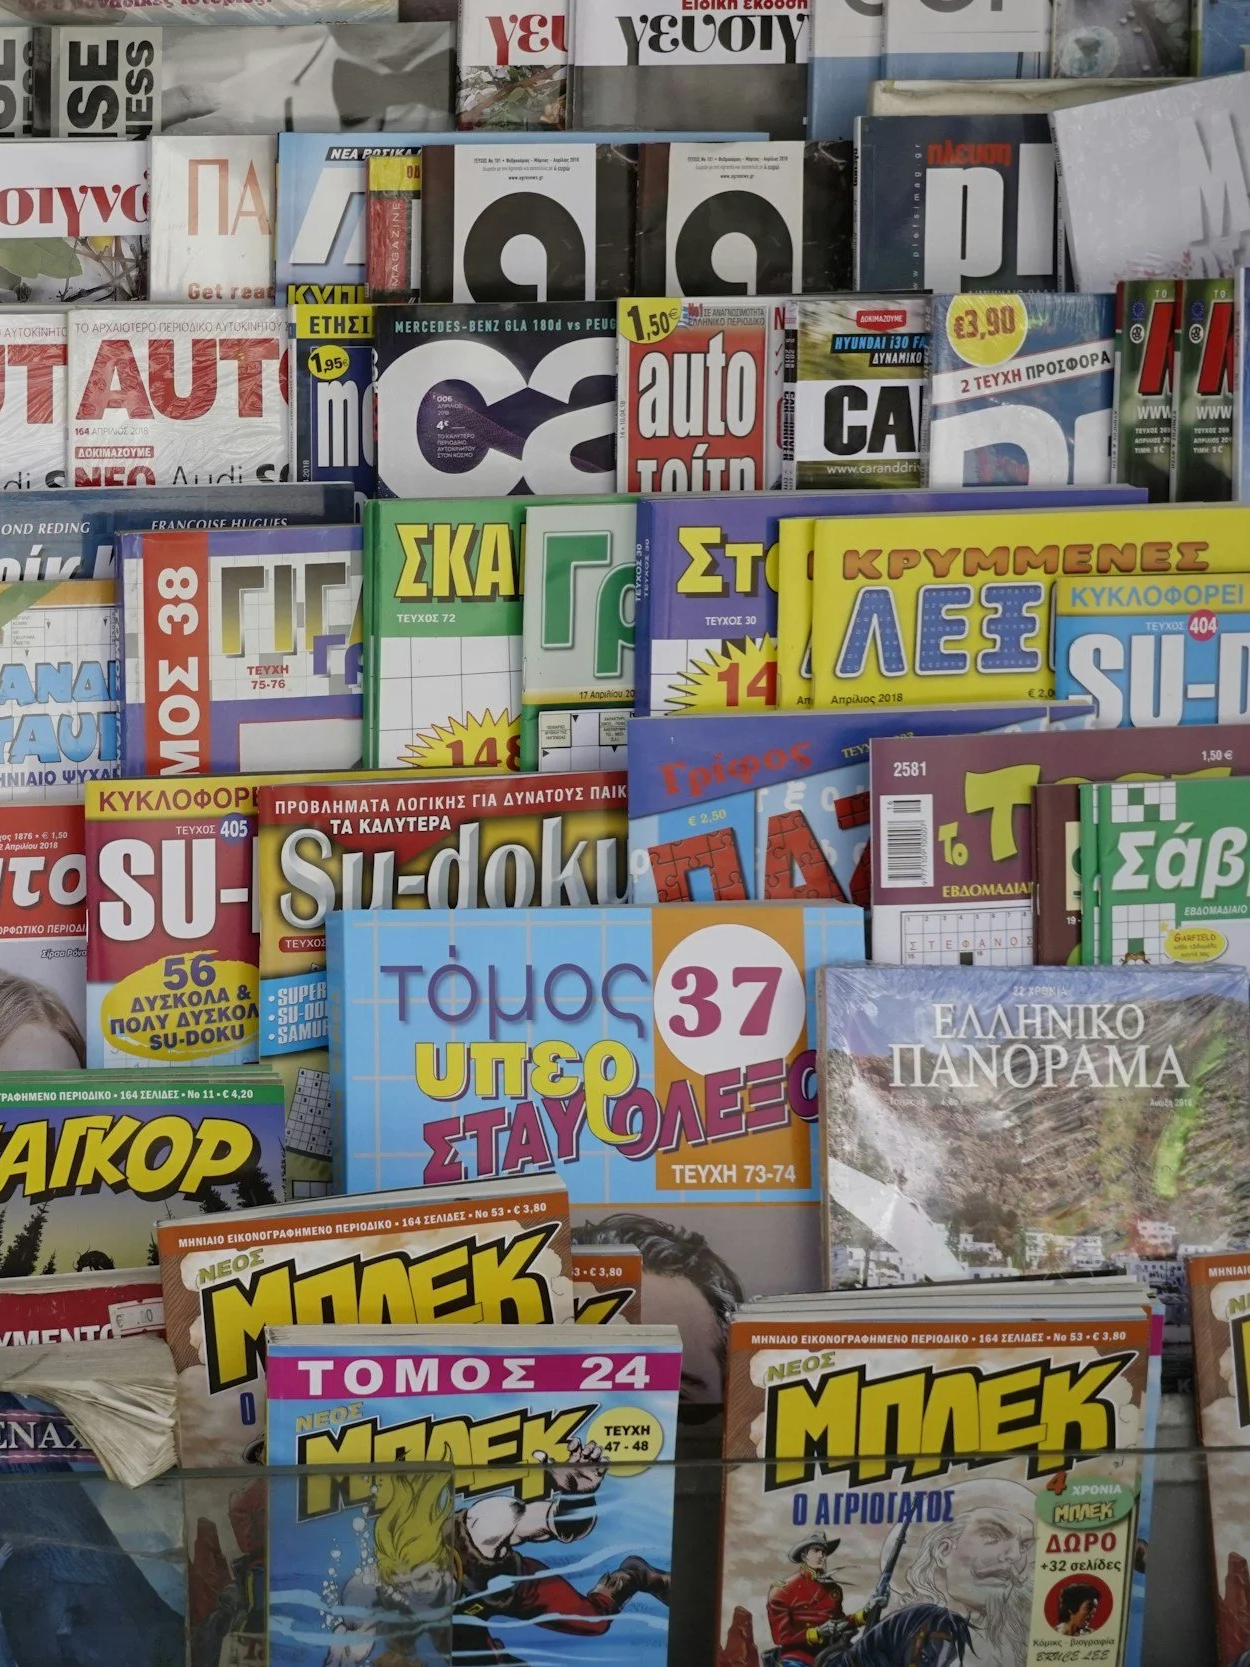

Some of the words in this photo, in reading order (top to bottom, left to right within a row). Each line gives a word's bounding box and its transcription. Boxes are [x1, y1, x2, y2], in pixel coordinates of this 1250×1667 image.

[92, 322, 156, 334] ΑΡΧΑΙΟΤΕΡΟ
[160, 322, 213, 333] ΠΕΡΙΟΔΙΚΟ
[395, 318, 499, 333] MERCEDES-BENZ
[505, 320, 527, 332] GLA
[533, 319, 562, 331] 180d
[834, 335, 885, 350] HYUNDAI
[975, 369, 1022, 391] ΤΕΥΧΗ
[1026, 351, 1110, 380] ΠΡΟΣΦΟΡΑ
[638, 330, 757, 438] auto
[40, 522, 90, 533] REDING
[843, 541, 1209, 580] ΚΡΥΜΜΕΝΕΣ
[1070, 584, 1245, 607] ΚΥΚΛΟΦΟΡΕΙ
[397, 614, 439, 623] ΤΕΥΧΟΣ
[442, 613, 456, 622] 72
[705, 616, 742, 626] ΤΕΥΧΟΣ
[744, 616, 756, 625] 30
[1146, 622, 1184, 631] ΤΕΥΧΟΣ
[1189, 617, 1217, 633] 404
[247, 664, 289, 676] ΤΕΥΧΗ
[251, 678, 286, 690] 75-76
[831, 694, 875, 705] Απρίλιος
[879, 692, 903, 702] 2018
[660, 741, 813, 796] Γρίφος
[893, 761, 927, 777] 2581
[276, 797, 390, 814] ΠΡΟΒΛΗΜΑΤΑ
[396, 794, 465, 812] ΛΟΓΙΚΗΣ
[472, 793, 498, 808] ΓΙΑ
[504, 786, 584, 806] ΔΥΝΑΤΟΥΣ
[176, 825, 215, 835] ΤΕΥΧΟΣ
[220, 818, 248, 838] 405
[330, 819, 351, 835] ΤΑ
[358, 815, 451, 834] ΚΑΛΥΤΕΡΑ
[14, 832, 33, 840] 1876
[5, 842, 36, 852] Απριλίου
[39, 841, 58, 849] 2018
[1184, 904, 1248, 916] ΕΒΔΟΜΑΔΙΑΙΟ
[163, 954, 216, 991] 56
[131, 989, 227, 1013] ΔΥΣΚΟΛΑ
[380, 945, 648, 1039] τόμος
[669, 965, 783, 1038] 37
[111, 1012, 166, 1035] ΠΟΛΥ
[933, 1002, 1146, 1041] ΕΛΛΗΝΙΚΟ
[149, 1024, 244, 1051] SU-DOKU
[889, 1043, 1190, 1089] ΠΑΝΟΡΑΜΑ
[59, 1090, 112, 1101] ΠΕΡΙΟΔΙΚΟ
[120, 1090, 138, 1100] 164
[140, 1090, 180, 1100] ΣΕΛΙΔΕΣ
[671, 1165, 736, 1184] ΤΕΥΧΗ
[744, 1164, 796, 1183] 73-74
[179, 1235, 224, 1248] ΜΗΝΙΑΙΟ
[227, 1225, 333, 1244] ΕΙΚΟΝΟΓΡΑΦΗΜΕΝΟ
[335, 1219, 392, 1234] ΠΕΡΙΟΔΙΚΟ
[402, 1216, 421, 1228] 164
[424, 1211, 466, 1226] ΣΕΛΙΔΕΣ
[198, 1248, 265, 1285] ΝΕΟΣ
[298, 1357, 536, 1396] ΤΟΜΟΣ
[579, 1355, 650, 1390] 24
[604, 1424, 651, 1437] ΤΕΥΧΗ
[1072, 1484, 1122, 1496] ΧΡΟΝΙΑ
[1046, 1532, 1117, 1554] ΔΩΡΟ
[1070, 1558, 1121, 1573] σελίδες
